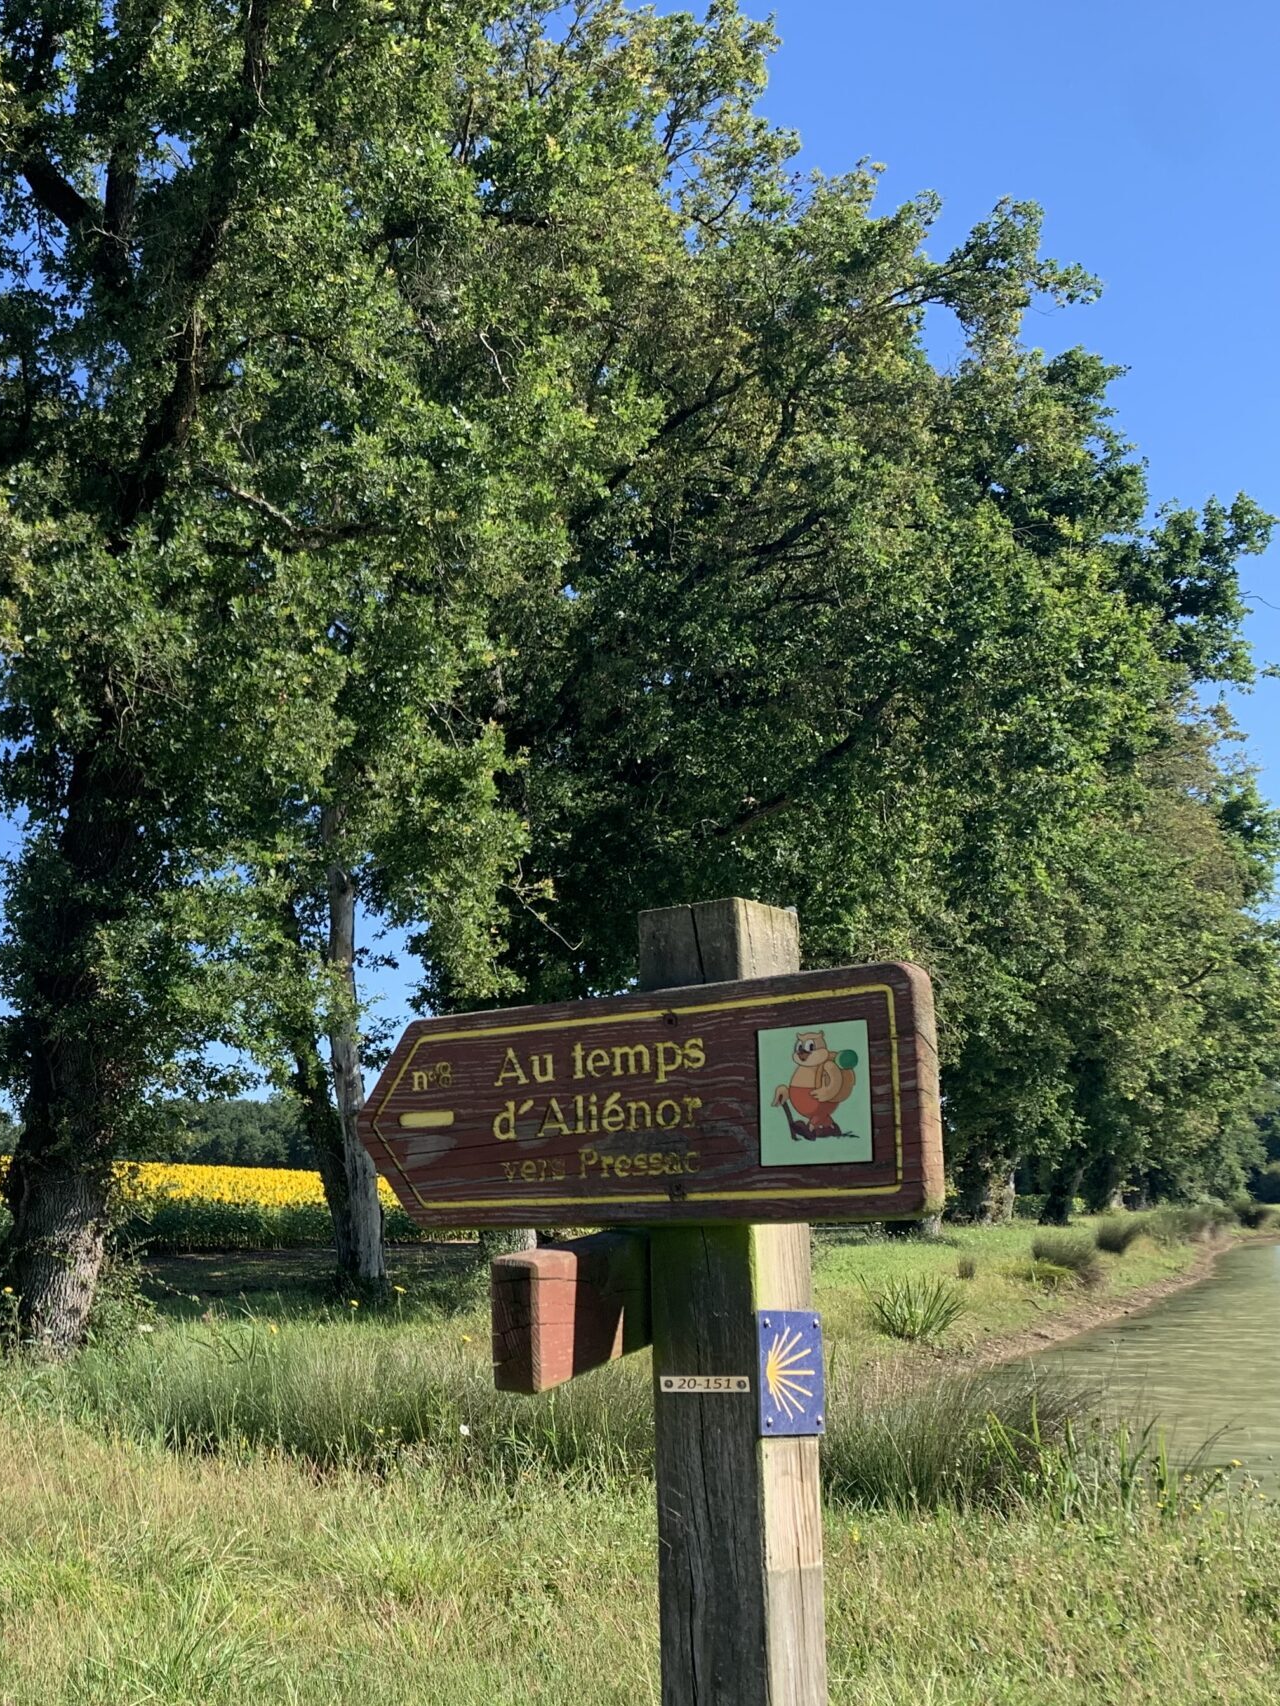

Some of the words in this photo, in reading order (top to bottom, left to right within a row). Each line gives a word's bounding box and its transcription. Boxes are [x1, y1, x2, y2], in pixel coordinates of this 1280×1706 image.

[494, 1047, 556, 1087] Au
[571, 1037, 706, 1084] temps
[501, 1157, 566, 1183] vers
[578, 1147, 701, 1180] Pressac
[677, 1378, 732, 1390] 20-151
